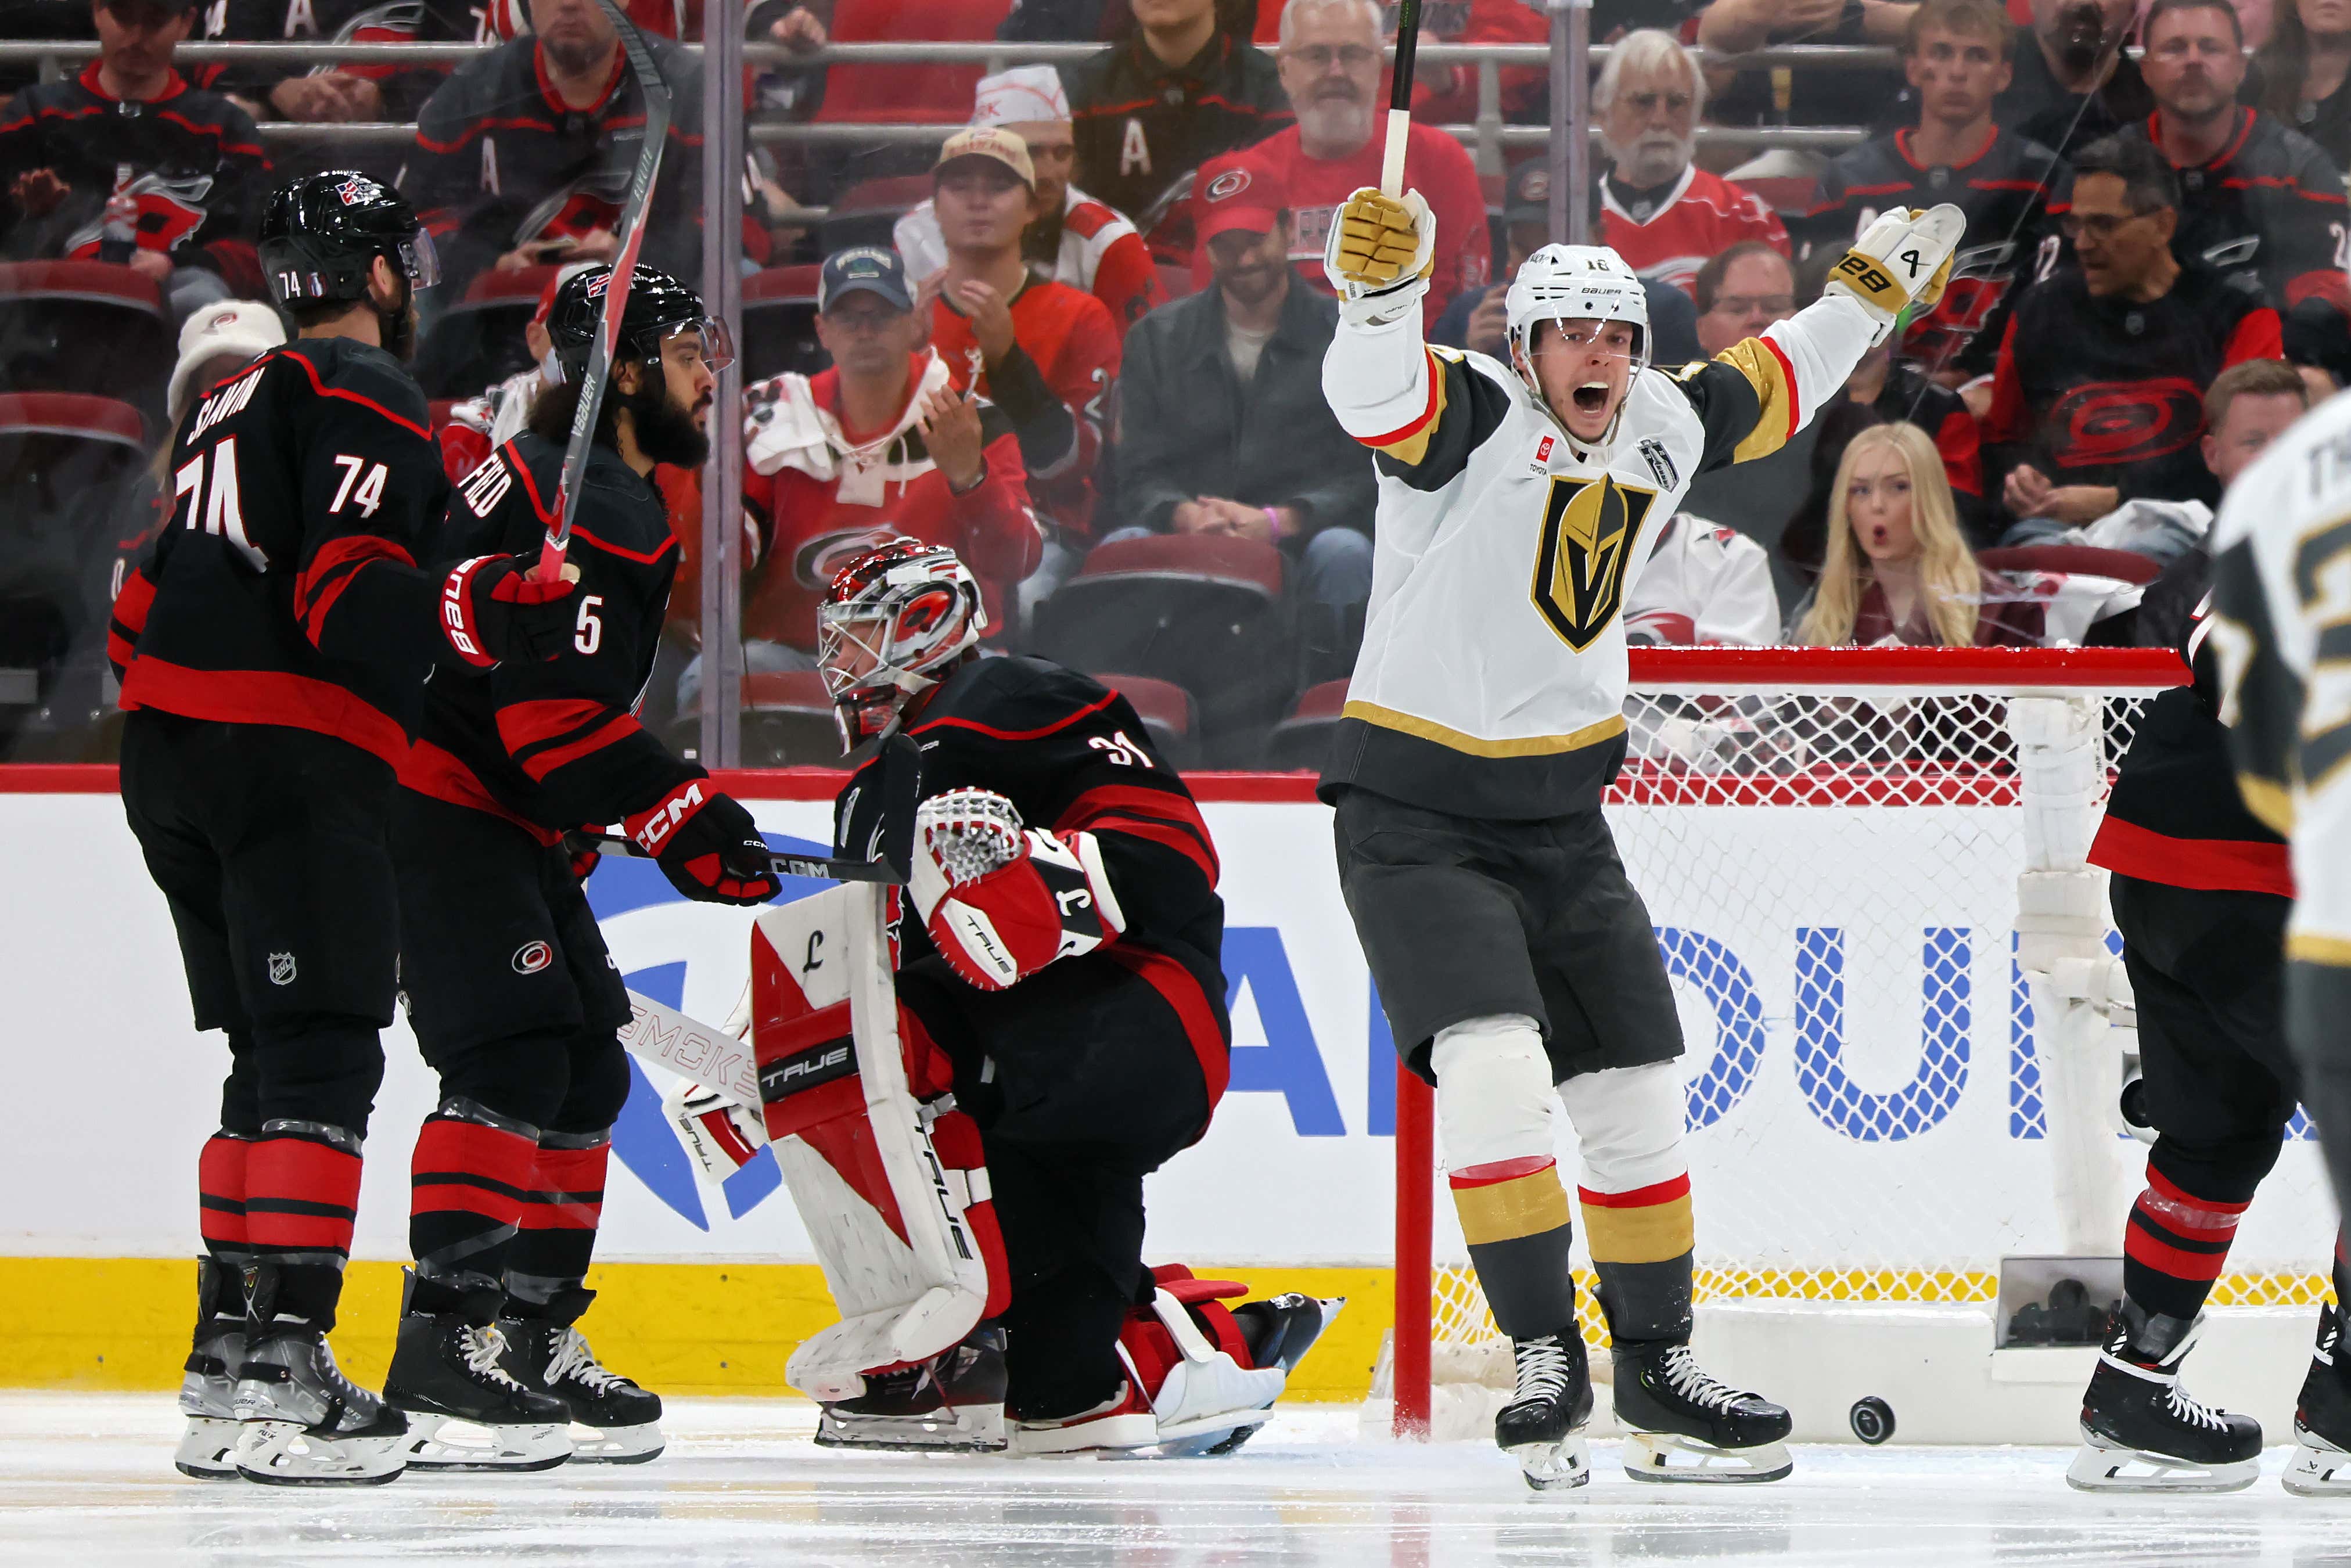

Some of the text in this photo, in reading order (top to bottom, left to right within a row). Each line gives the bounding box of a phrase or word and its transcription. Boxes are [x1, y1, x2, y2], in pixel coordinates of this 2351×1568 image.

[480, 136, 500, 196] A
[1120, 118, 1151, 176] A
[278, 270, 301, 299] 74
[1581, 287, 1622, 295] BAUER
[186, 366, 267, 447] SLAVIN
[574, 372, 596, 432] BAUER
[328, 454, 389, 519] 74
[1529, 463, 1547, 476] TOYOTA
[574, 594, 603, 655] 5
[1087, 729, 1155, 769] 31
[636, 783, 704, 853] CCM
[743, 839, 769, 850] CCM
[770, 858, 831, 879] CCM
[274, 959, 290, 979] NHL
[966, 914, 1013, 975] TRUE
[761, 1046, 849, 1088] TRUE
[914, 1125, 974, 1260] TRUE
